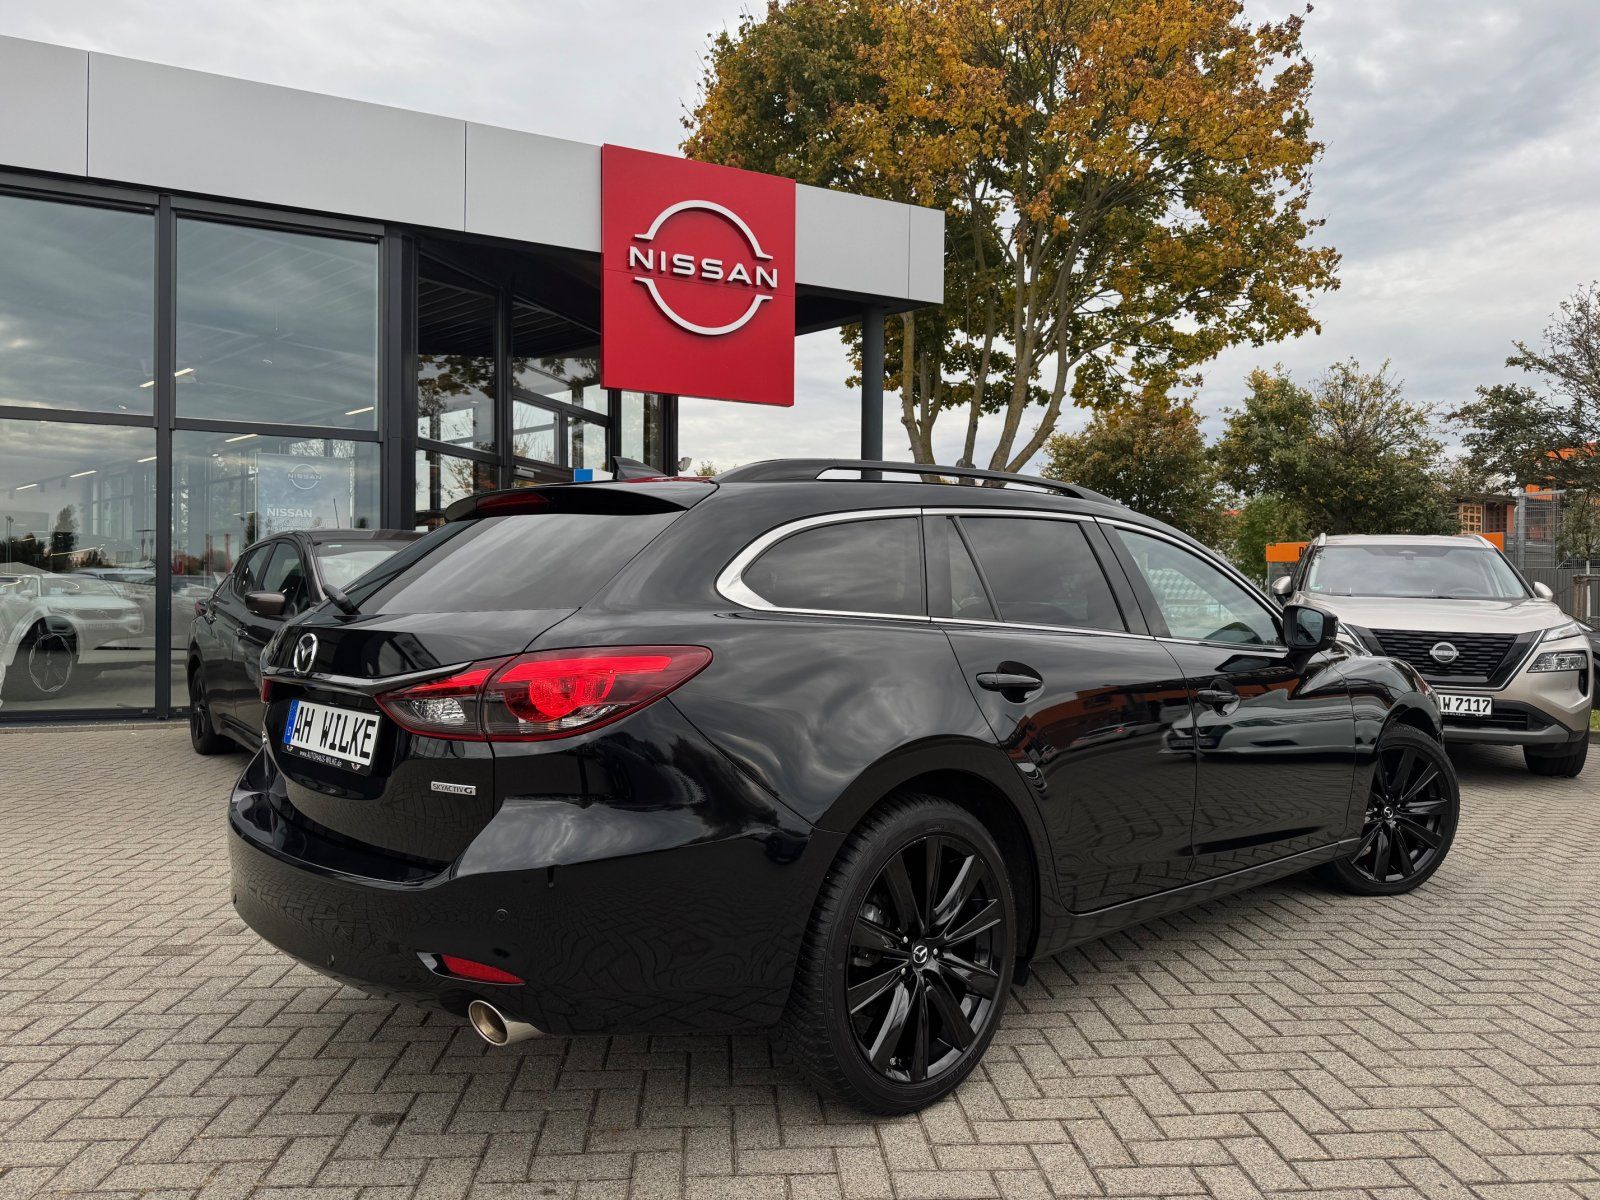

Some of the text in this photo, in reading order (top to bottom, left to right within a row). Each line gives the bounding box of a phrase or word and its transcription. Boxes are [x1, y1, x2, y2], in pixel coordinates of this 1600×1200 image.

[629, 246, 778, 288] NISSAN
[266, 507, 313, 518] NISSAN
[1455, 697, 1491, 713] 7117
[292, 706, 315, 744] AH
[320, 711, 377, 760] WILKE
